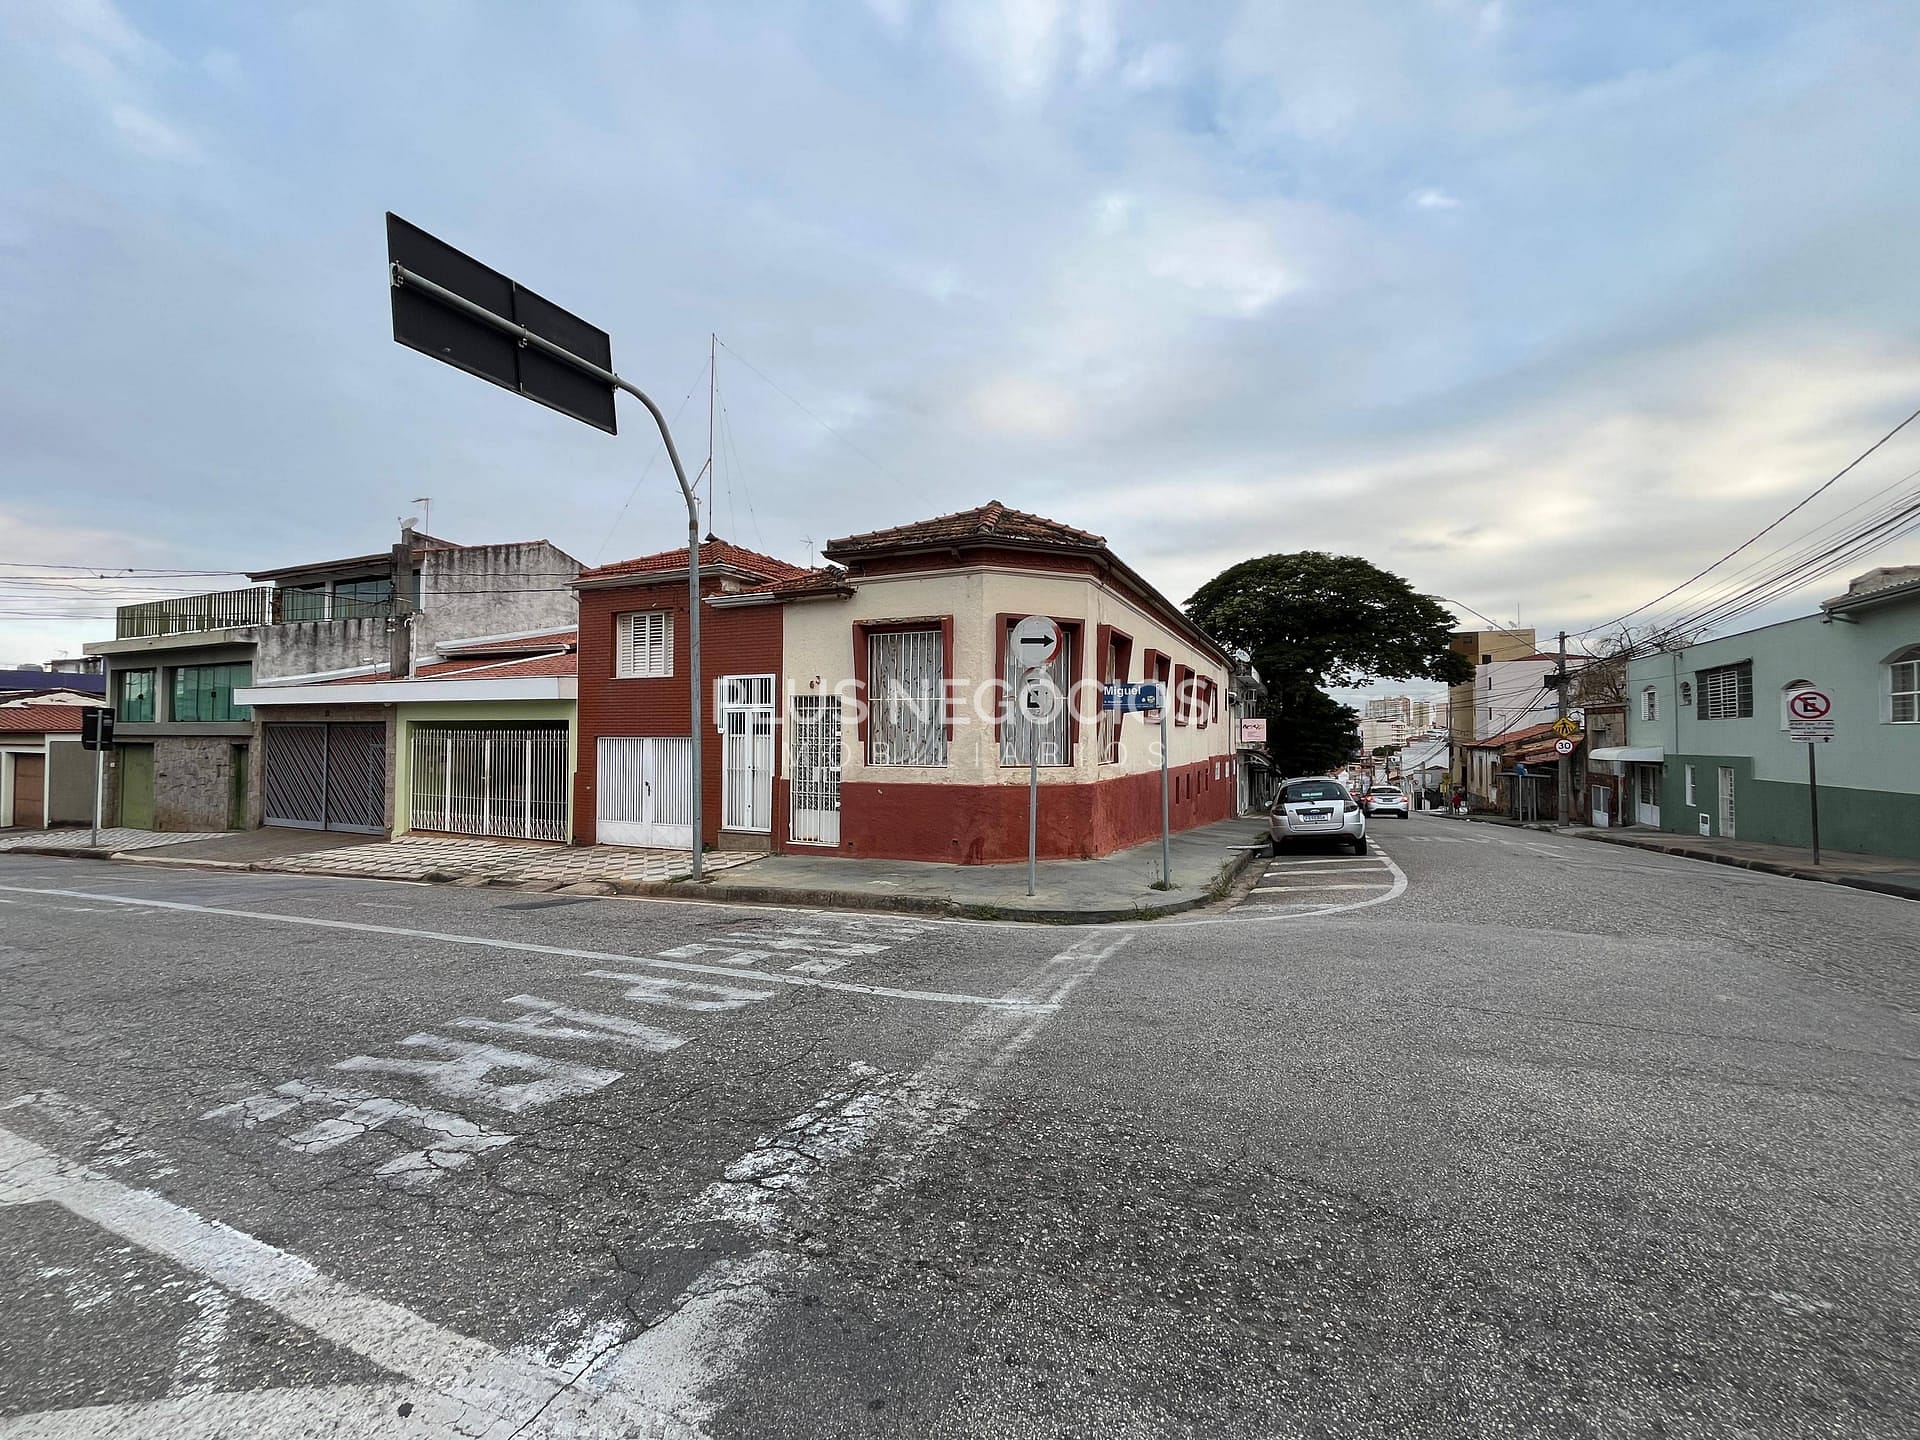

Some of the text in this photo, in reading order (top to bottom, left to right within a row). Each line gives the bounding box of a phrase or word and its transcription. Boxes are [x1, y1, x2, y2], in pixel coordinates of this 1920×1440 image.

[1104, 686, 1141, 697] Miguel
[1558, 741, 1571, 750] 30
[197, 968, 777, 1189] PARE
